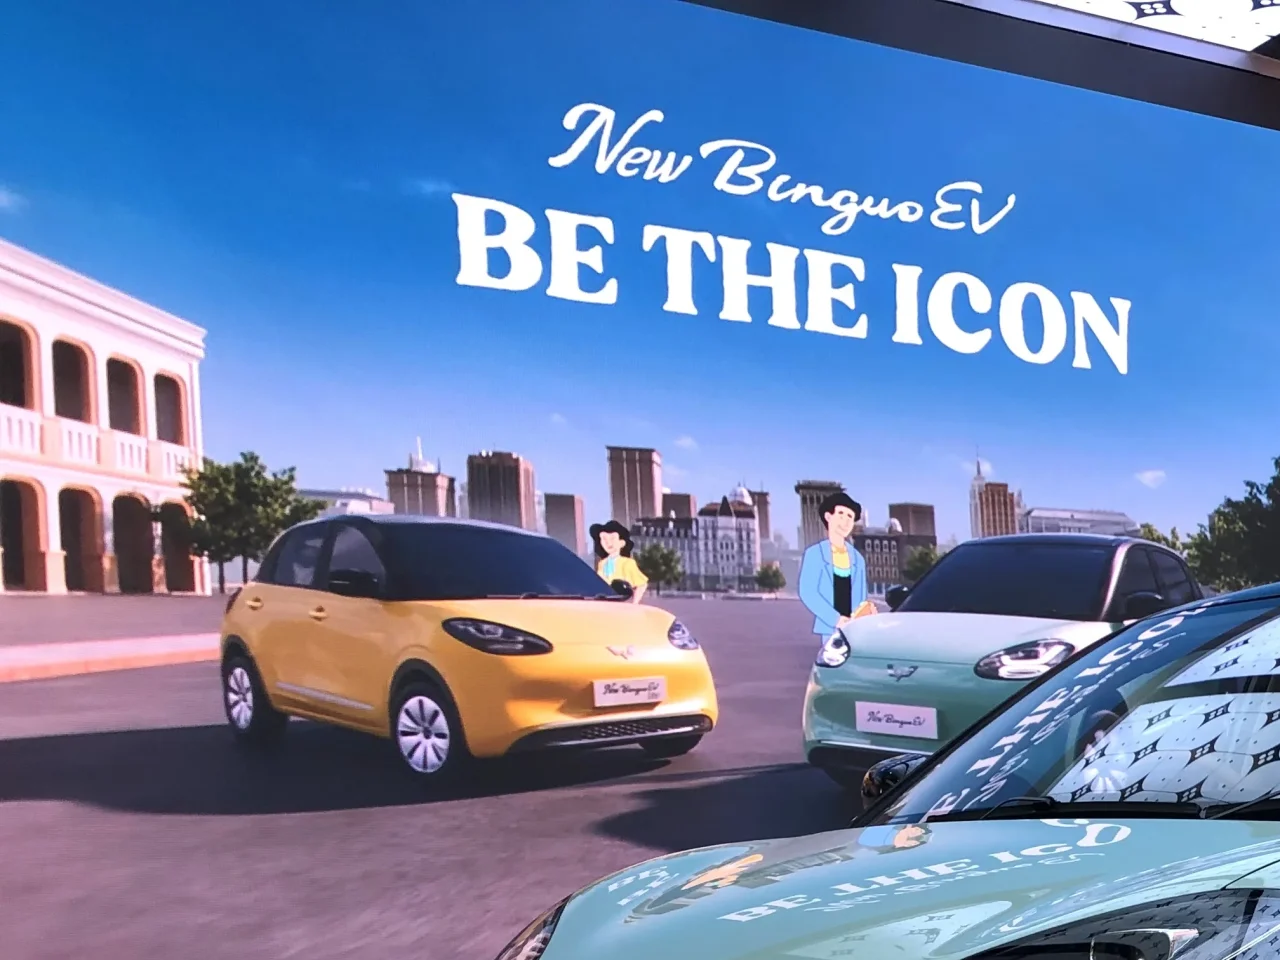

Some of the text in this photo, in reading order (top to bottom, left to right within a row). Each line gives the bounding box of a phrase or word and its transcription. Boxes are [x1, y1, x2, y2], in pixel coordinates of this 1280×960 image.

[549, 103, 1015, 235] New Binguo EV
[452, 193, 1131, 374] BE THE ICON
